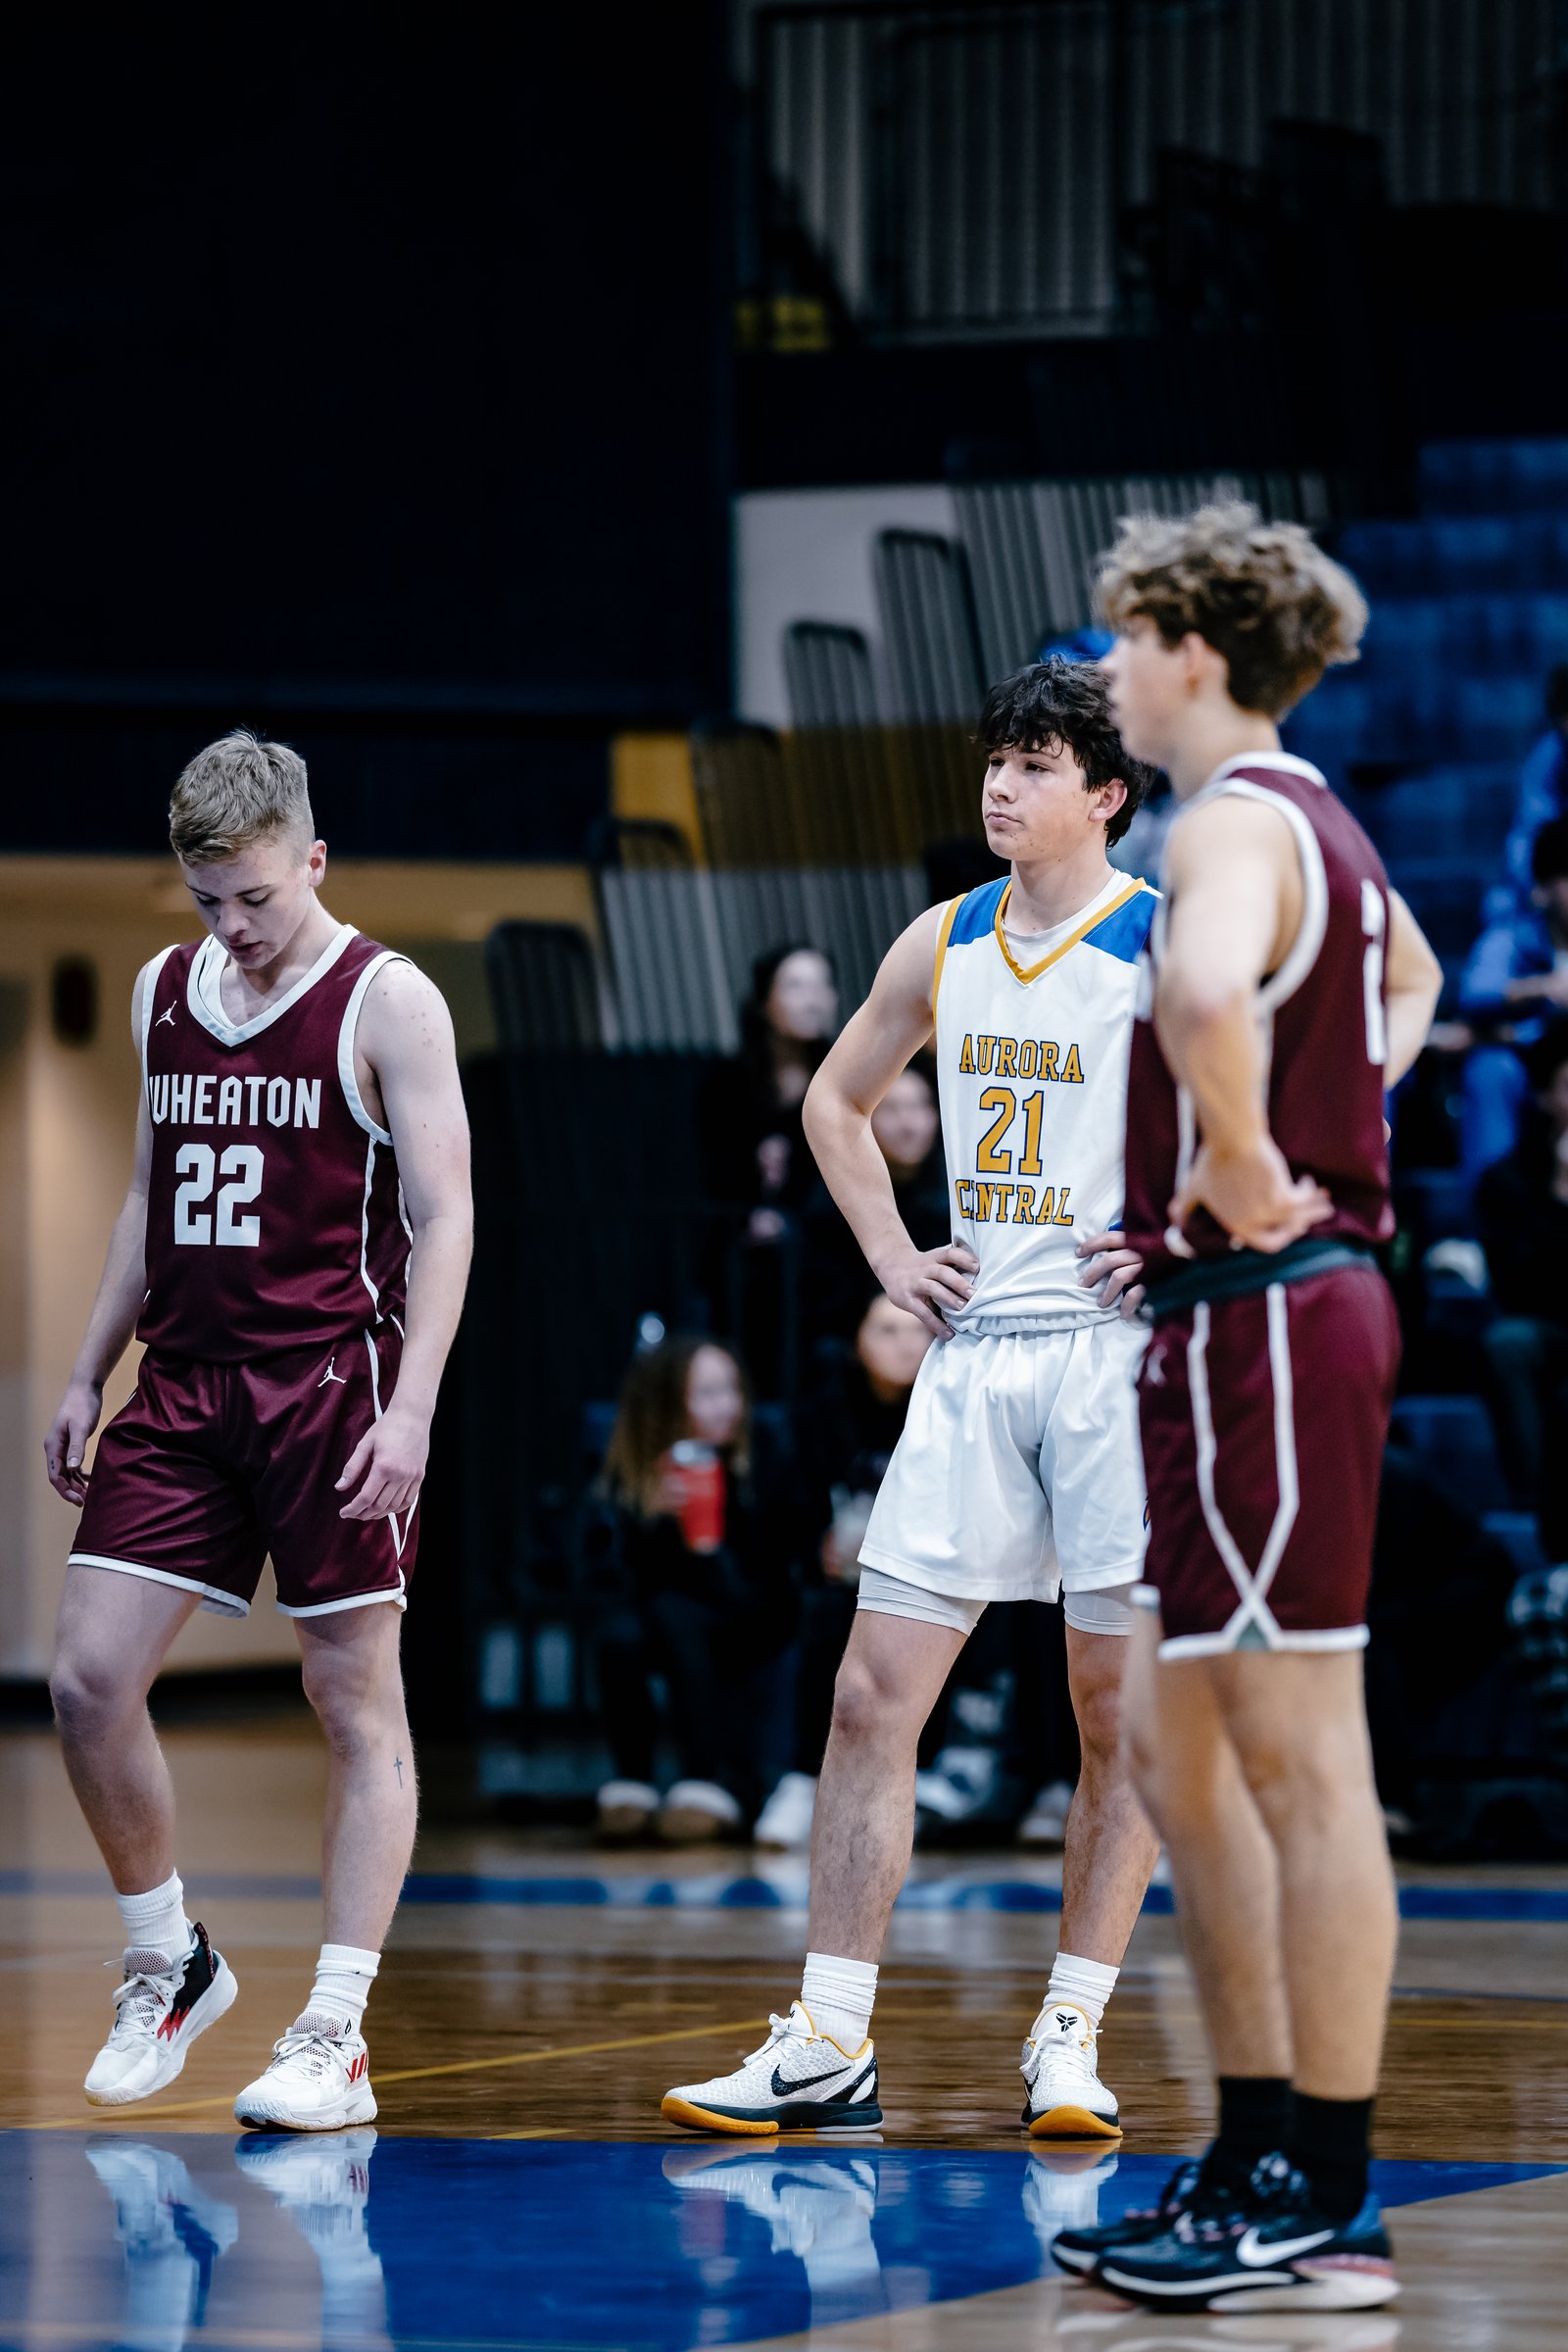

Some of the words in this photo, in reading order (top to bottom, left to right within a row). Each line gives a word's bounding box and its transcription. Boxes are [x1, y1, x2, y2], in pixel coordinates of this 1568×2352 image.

[959, 1034, 1084, 1083] AURORA
[149, 1074, 322, 1128] WHEATON
[976, 1086, 1044, 1176] 21
[174, 1144, 265, 1247] 22
[956, 1179, 1074, 1226] CNTRAL
